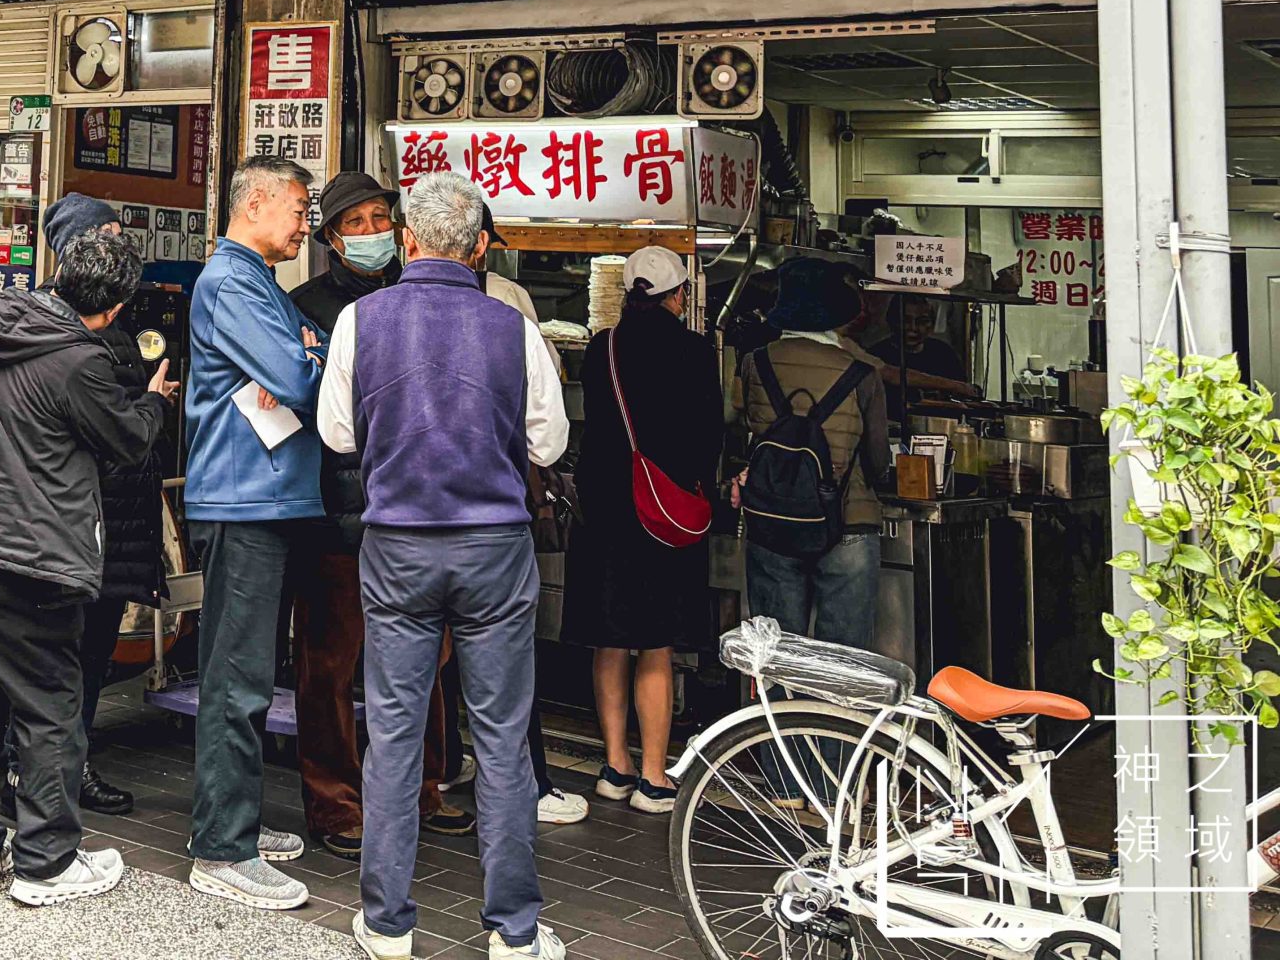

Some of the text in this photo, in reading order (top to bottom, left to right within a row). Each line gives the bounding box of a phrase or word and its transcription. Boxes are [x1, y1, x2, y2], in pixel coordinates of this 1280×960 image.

[267, 34, 313, 90] 售
[27, 114, 42, 130] 12
[254, 103, 323, 129] 莊敬路
[4, 143, 29, 157] 警告
[254, 134, 323, 159] 金店面
[398, 128, 685, 205] 藥燉排骨
[698, 151, 758, 213] 飯麵湯
